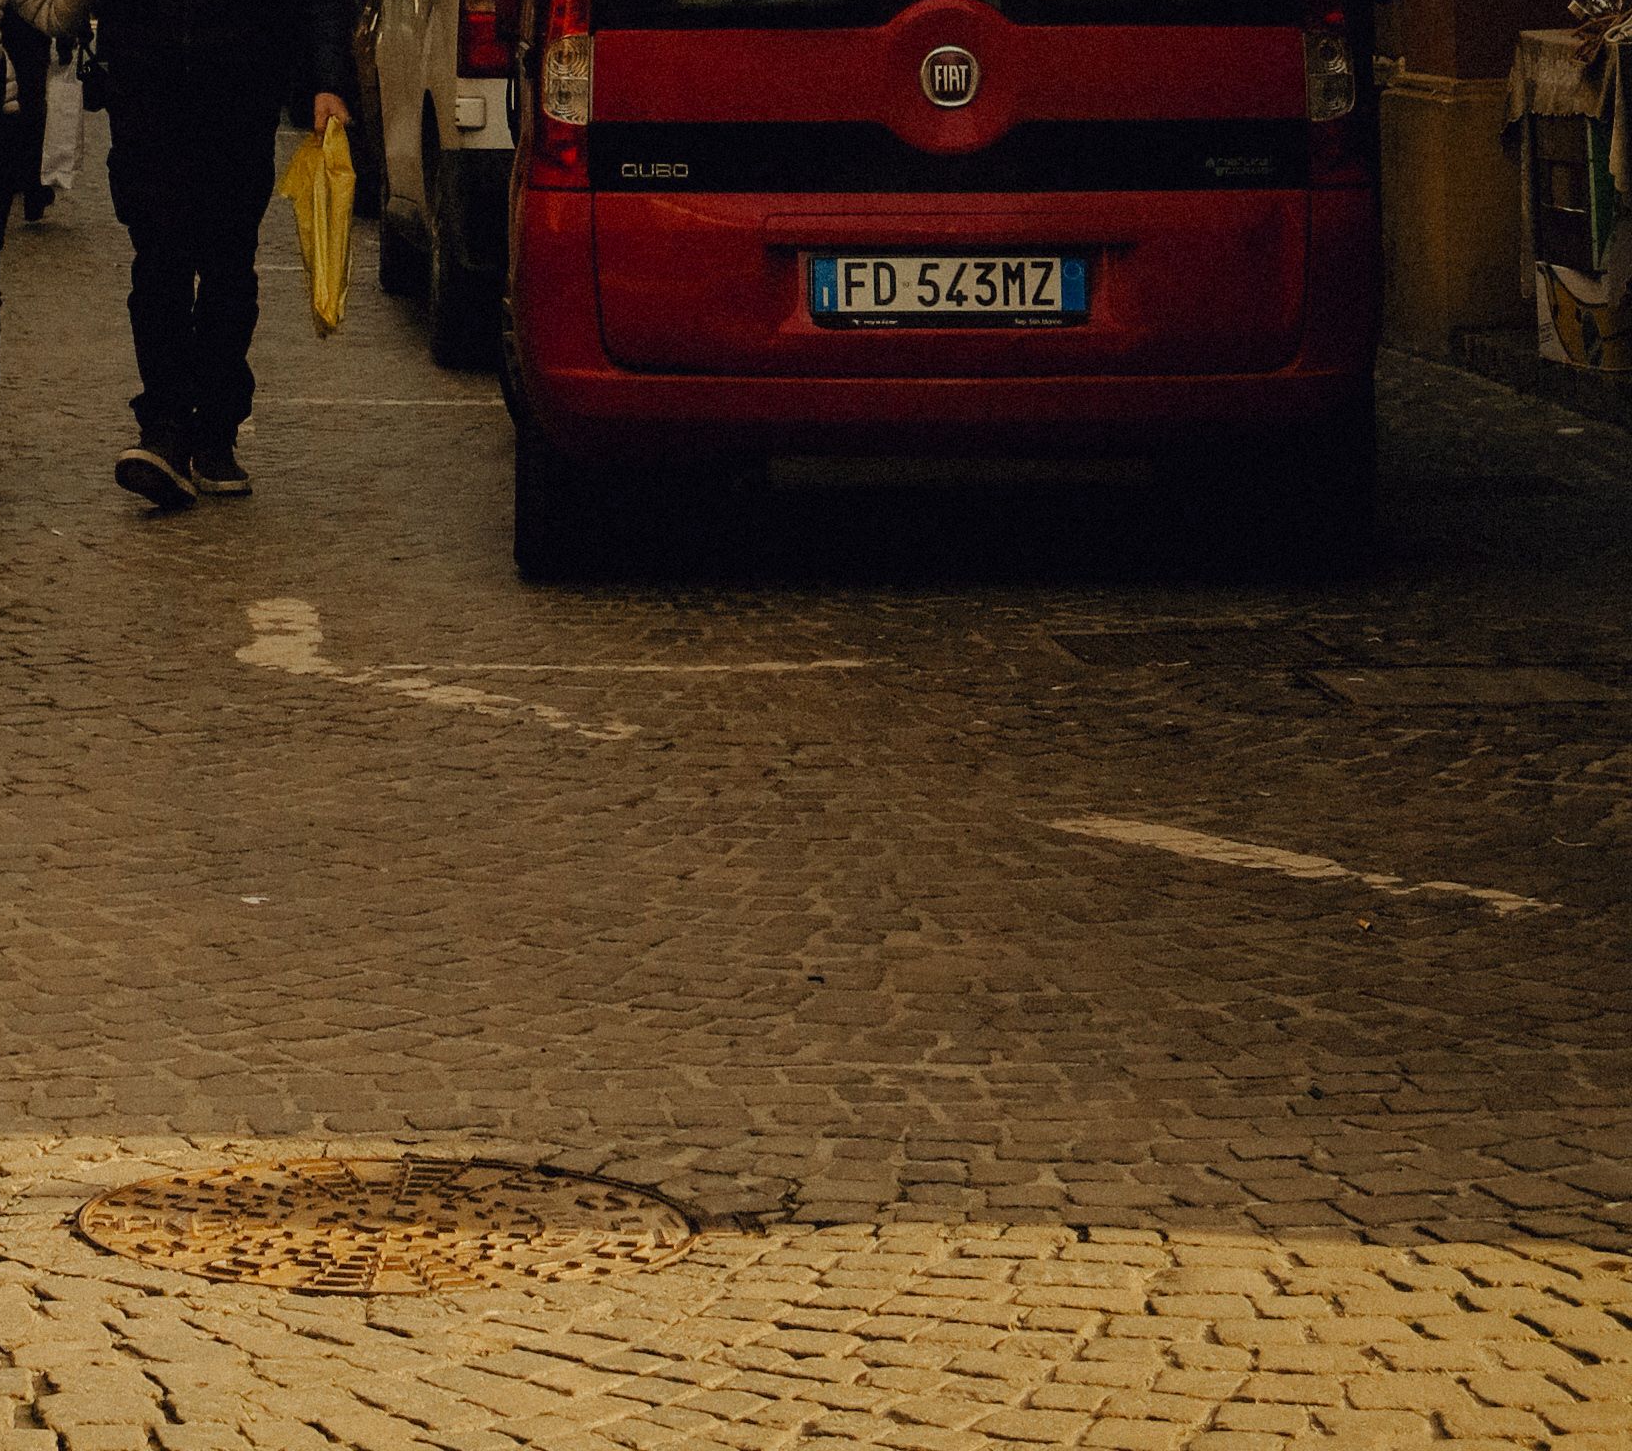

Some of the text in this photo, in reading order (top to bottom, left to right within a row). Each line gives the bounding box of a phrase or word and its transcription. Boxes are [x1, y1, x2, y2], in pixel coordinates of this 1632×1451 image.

[933, 64, 969, 93] FIAT
[620, 162, 690, 179] QUBO
[843, 261, 897, 308] FD
[916, 262, 1056, 308] 543MZ
